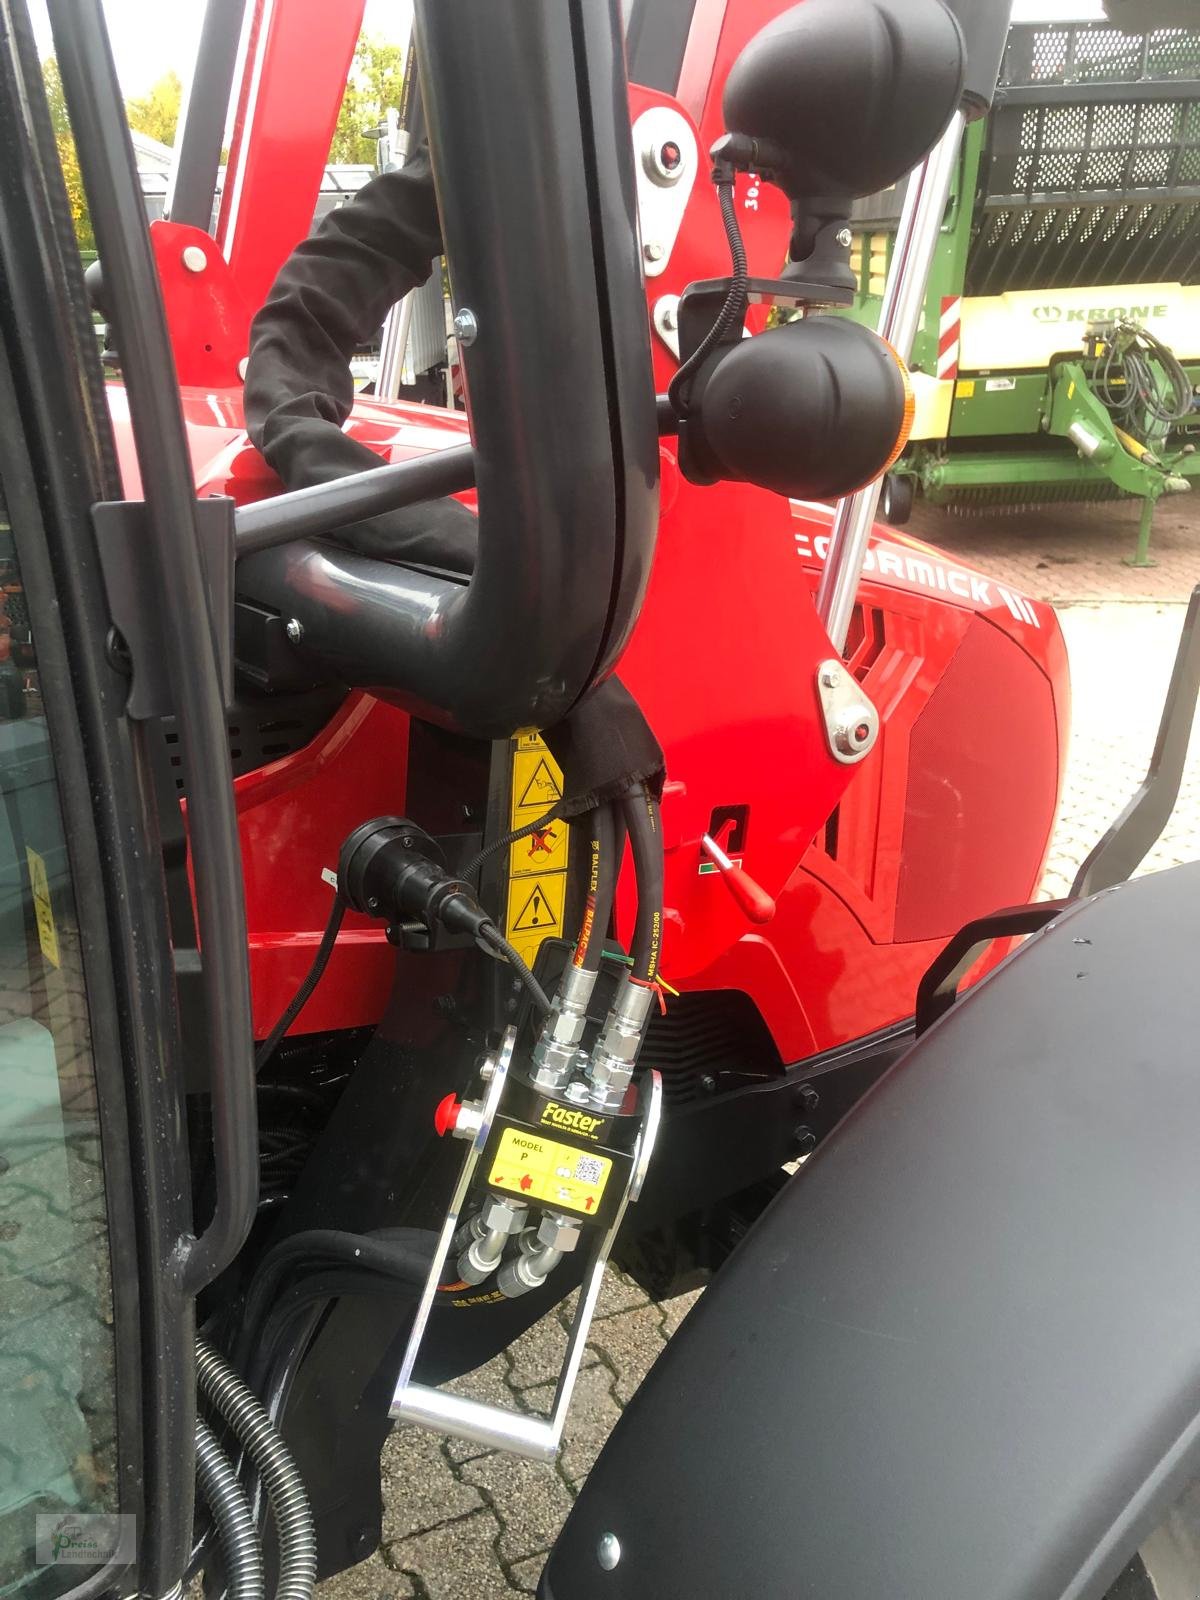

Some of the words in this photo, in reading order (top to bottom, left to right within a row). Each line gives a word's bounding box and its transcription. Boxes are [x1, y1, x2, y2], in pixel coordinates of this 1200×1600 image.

[1067, 305, 1168, 322] KRONE
[590, 853, 599, 892] BALFLEX
[580, 909, 595, 950] BALPAC
[647, 950, 658, 977] MSHA
[542, 1101, 604, 1132] Faster
[511, 1137, 544, 1153] MODEL
[520, 1152, 529, 1161] P
